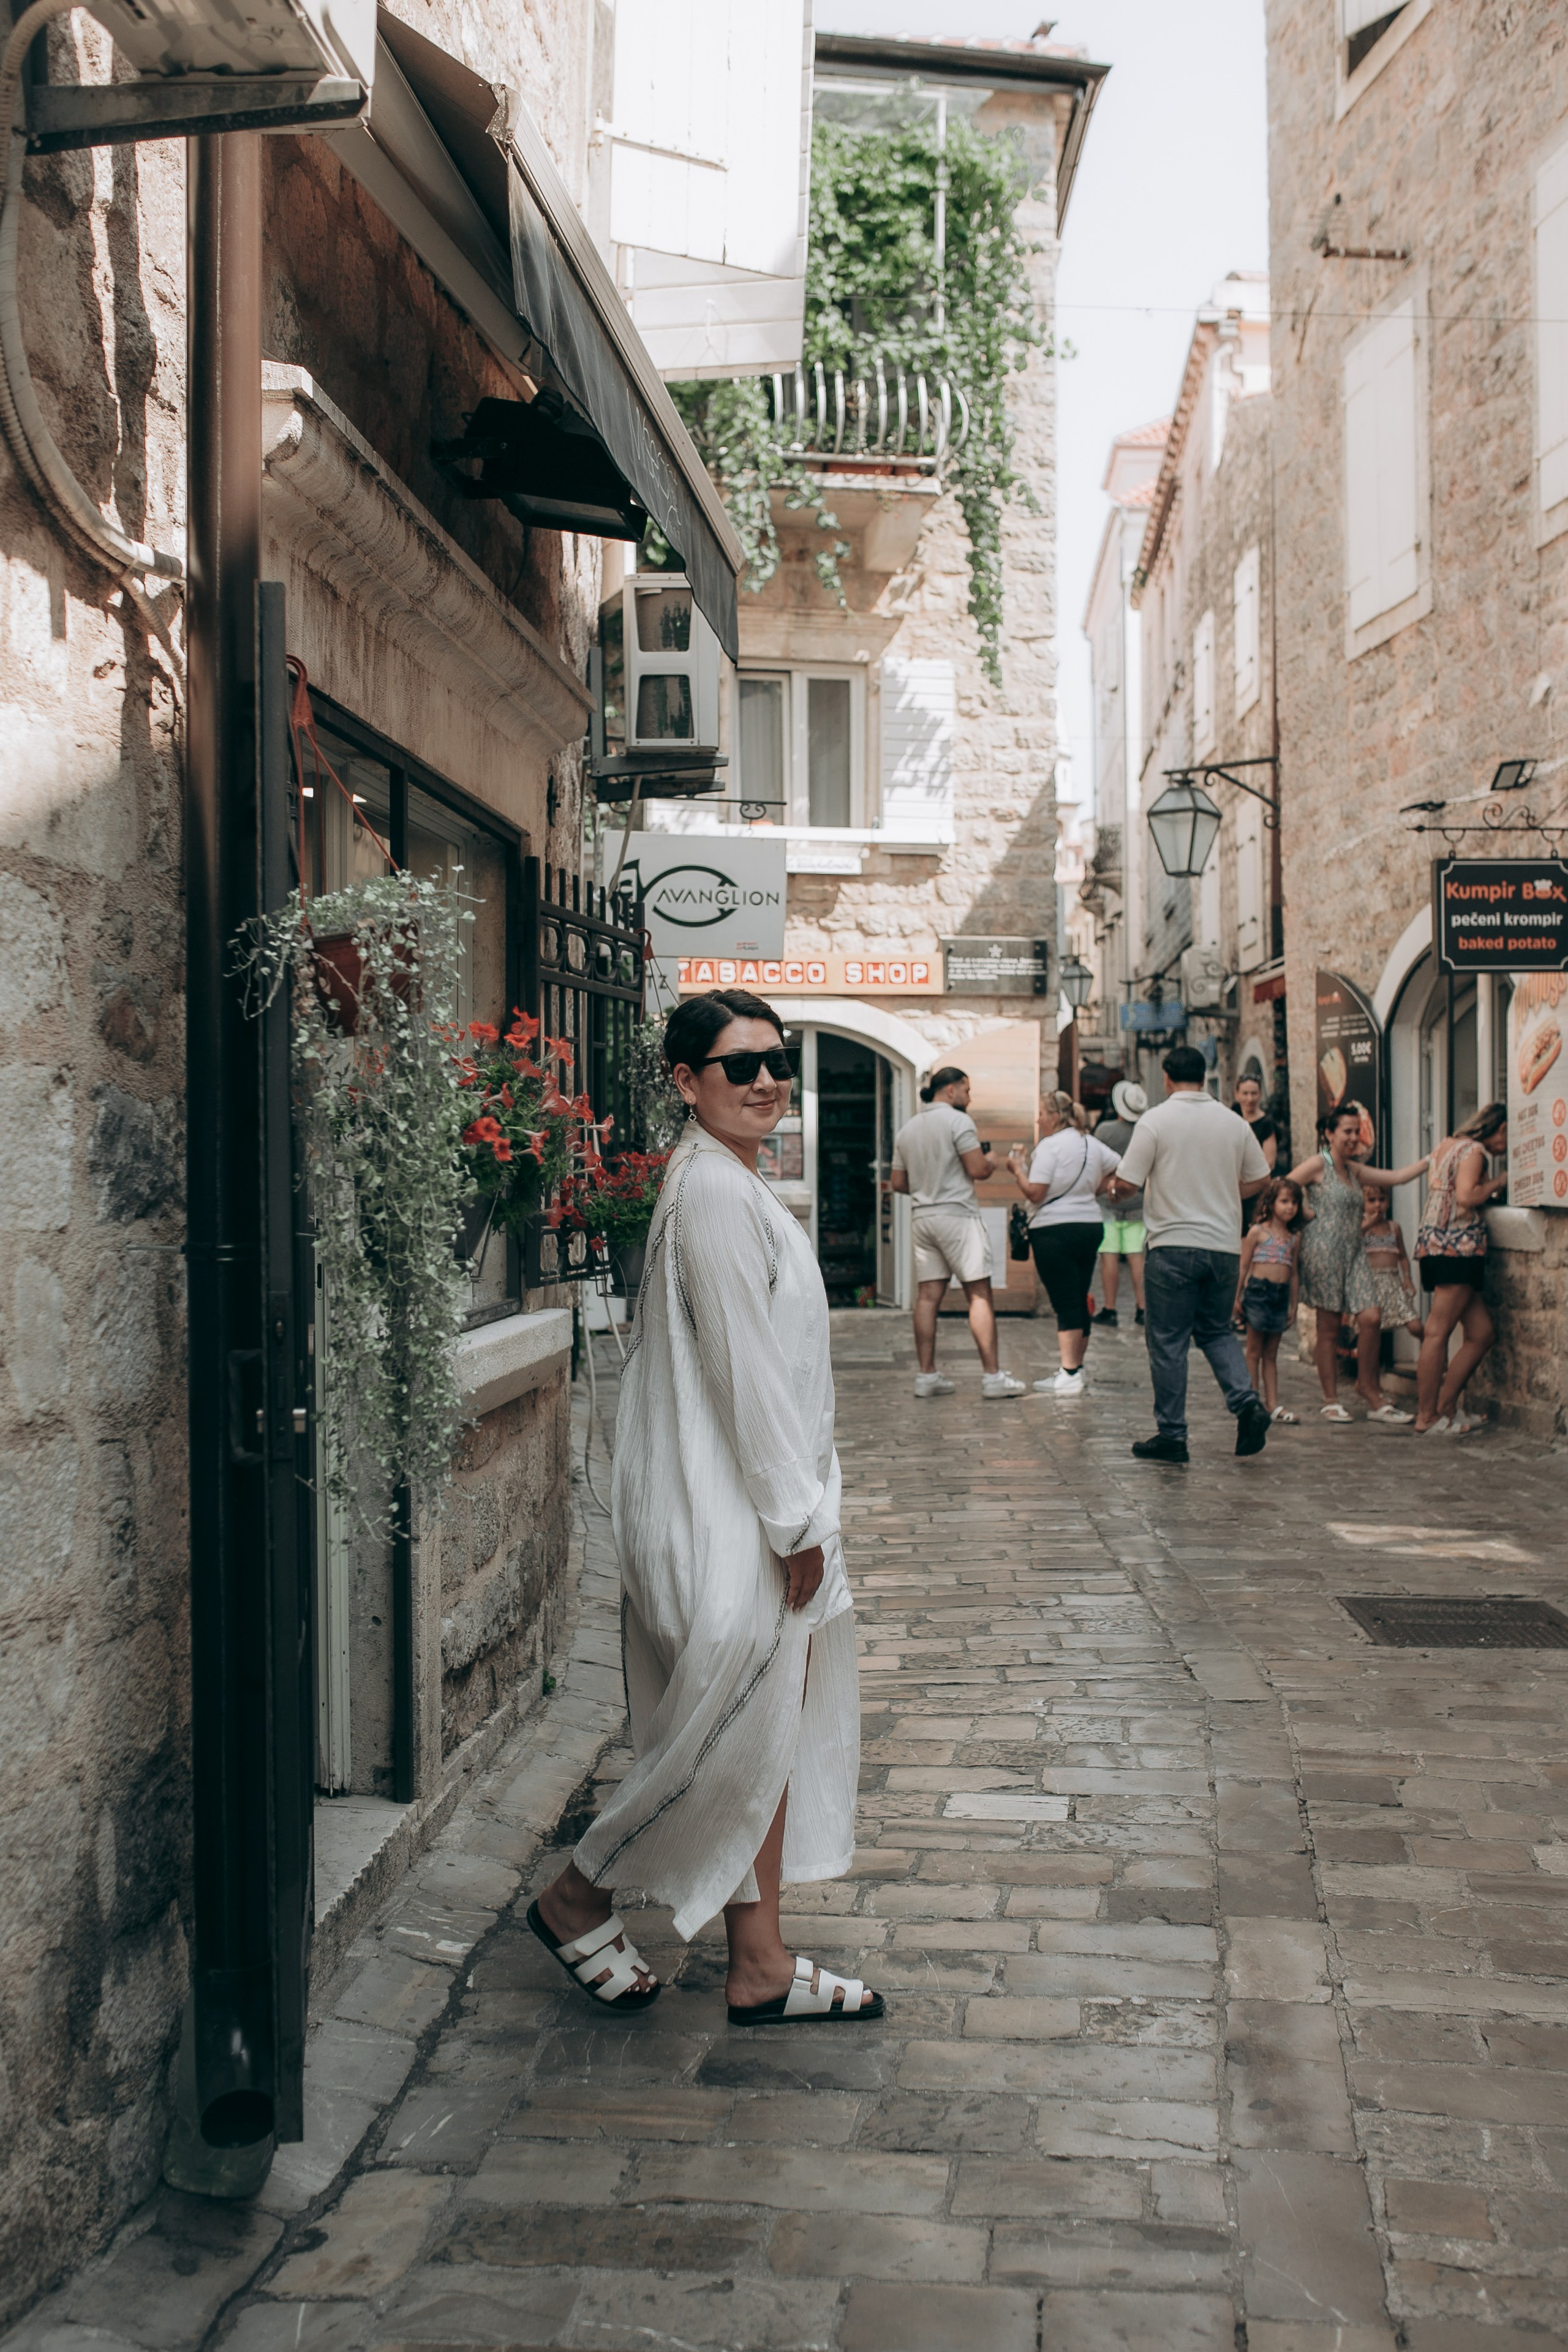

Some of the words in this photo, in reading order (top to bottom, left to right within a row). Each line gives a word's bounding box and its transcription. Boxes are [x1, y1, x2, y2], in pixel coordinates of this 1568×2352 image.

[657, 888, 780, 906] AVANGLION
[1446, 880, 1516, 903] Kumpir
[1451, 911, 1501, 928] pečeni
[1504, 911, 1563, 927] krompir
[1458, 936, 1504, 950] baked
[1507, 936, 1557, 951] potato
[677, 962, 826, 984] TABACCO
[845, 962, 927, 984] SHOP
